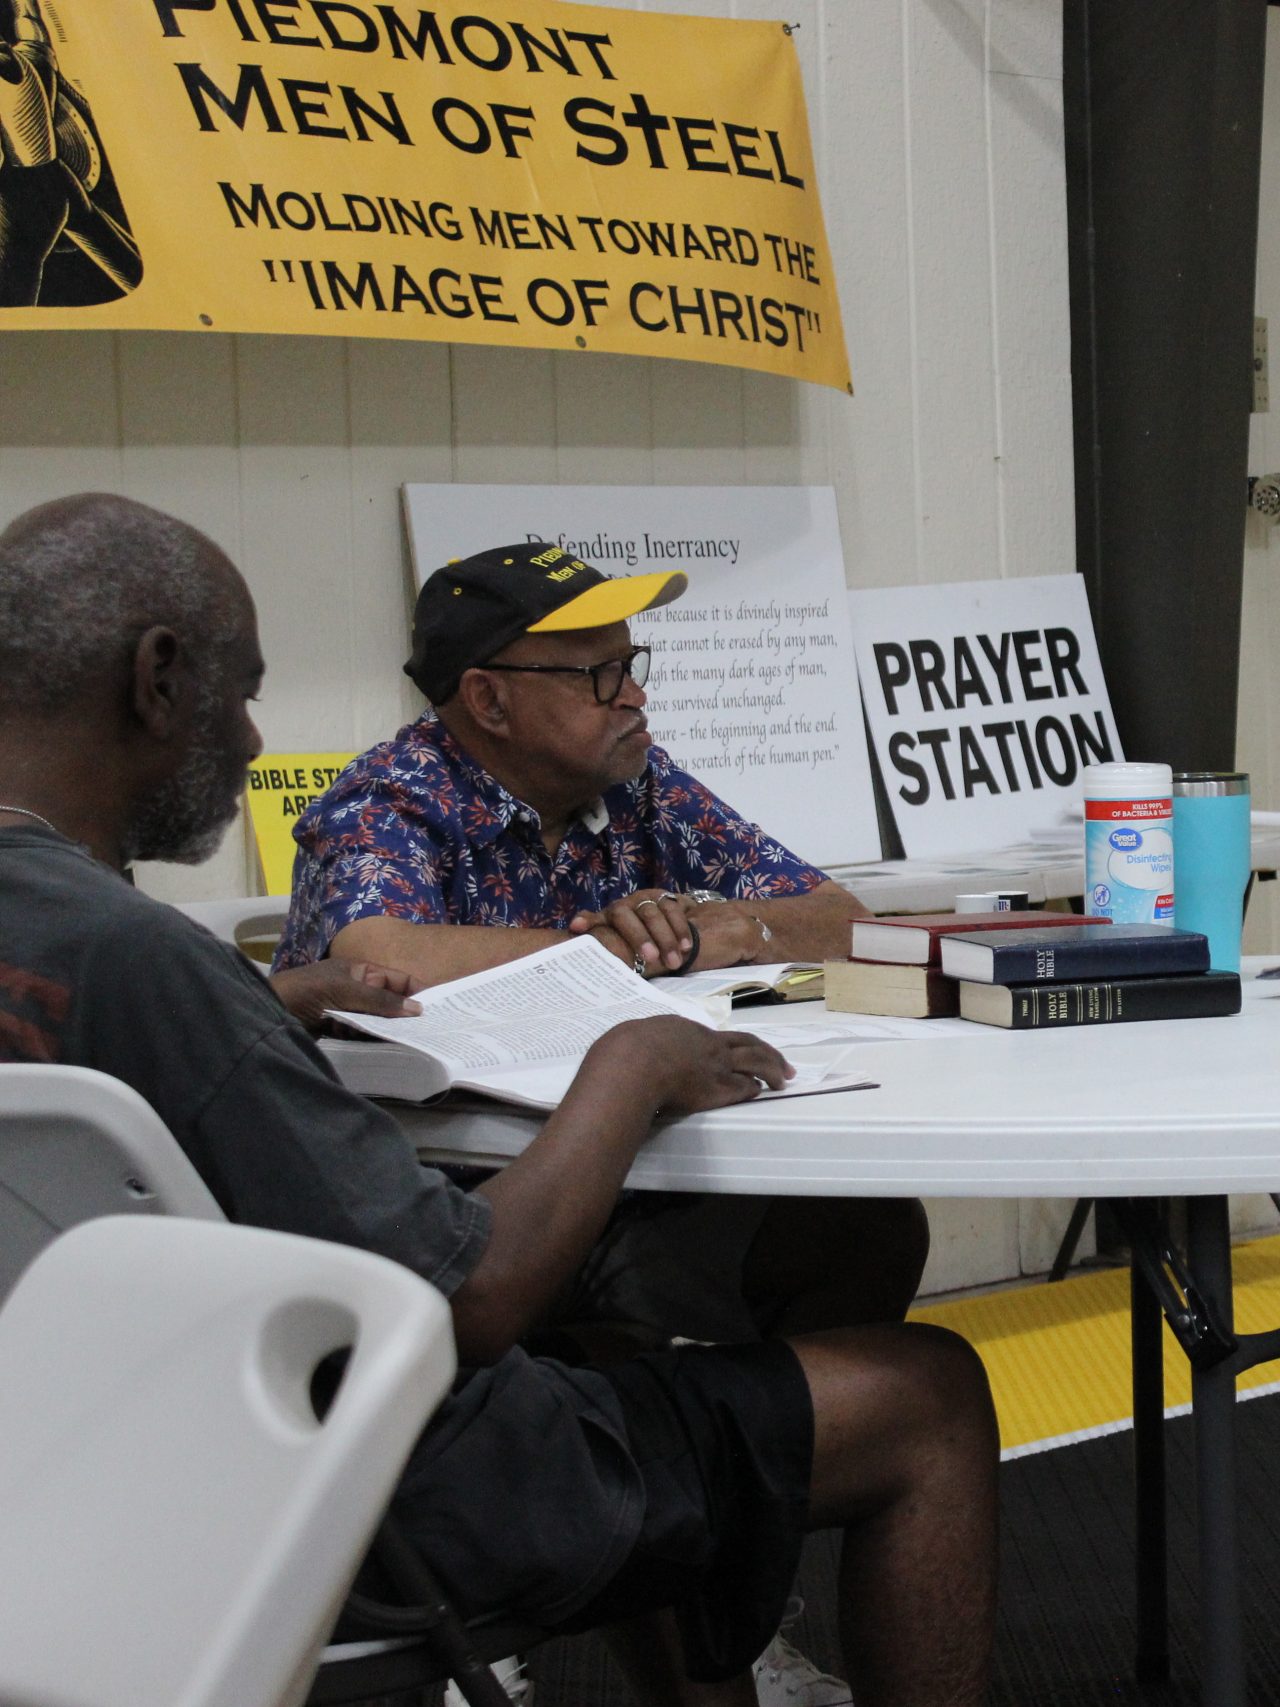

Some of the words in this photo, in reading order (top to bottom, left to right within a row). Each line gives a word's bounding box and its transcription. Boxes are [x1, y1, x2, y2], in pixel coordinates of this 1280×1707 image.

[174, 62, 415, 146] MEN
[432, 97, 537, 158] OF
[217, 181, 464, 241] MOLDING
[469, 206, 577, 250] MEN
[577, 216, 760, 266] TOWARD
[763, 232, 821, 286] THE
[526, 278, 610, 326] OF
[643, 533, 741, 564] Inerrancy
[665, 604, 708, 623] because
[711, 604, 721, 621] it
[725, 604, 734, 621] is
[736, 599, 781, 628] divinely
[785, 598, 830, 627] inspired
[671, 633, 710, 652] cannot
[713, 630, 726, 649] be
[729, 628, 763, 649] erased
[766, 627, 782, 656] by
[784, 635, 806, 656] any
[809, 631, 838, 648] man,
[671, 660, 689, 681] the
[692, 667, 725, 688] many
[728, 658, 756, 679] dark
[758, 666, 782, 688] ages
[784, 657, 797, 685] of
[799, 661, 828, 677] man,
[873, 627, 1090, 716] PRAYER
[671, 688, 718, 712] survived
[722, 686, 787, 714] unchanged.
[690, 719, 708, 740] the
[710, 717, 767, 746] beginning
[770, 713, 792, 735] and
[794, 713, 813, 734] the
[815, 711, 838, 732] end.
[691, 747, 732, 769] scratch
[734, 750, 746, 775] of
[749, 747, 767, 766] the
[768, 744, 809, 765] human
[888, 711, 1115, 806] STATION
[250, 768, 308, 790] BIBLE
[312, 767, 341, 790] ST
[1122, 809, 1153, 817] BACTERIA
[1112, 833, 1137, 842] Great
[1036, 950, 1046, 979] HOLY
[1046, 949, 1055, 978] BIBLE
[1048, 993, 1057, 1020] HOLY
[1059, 991, 1068, 1019] BIBLE
